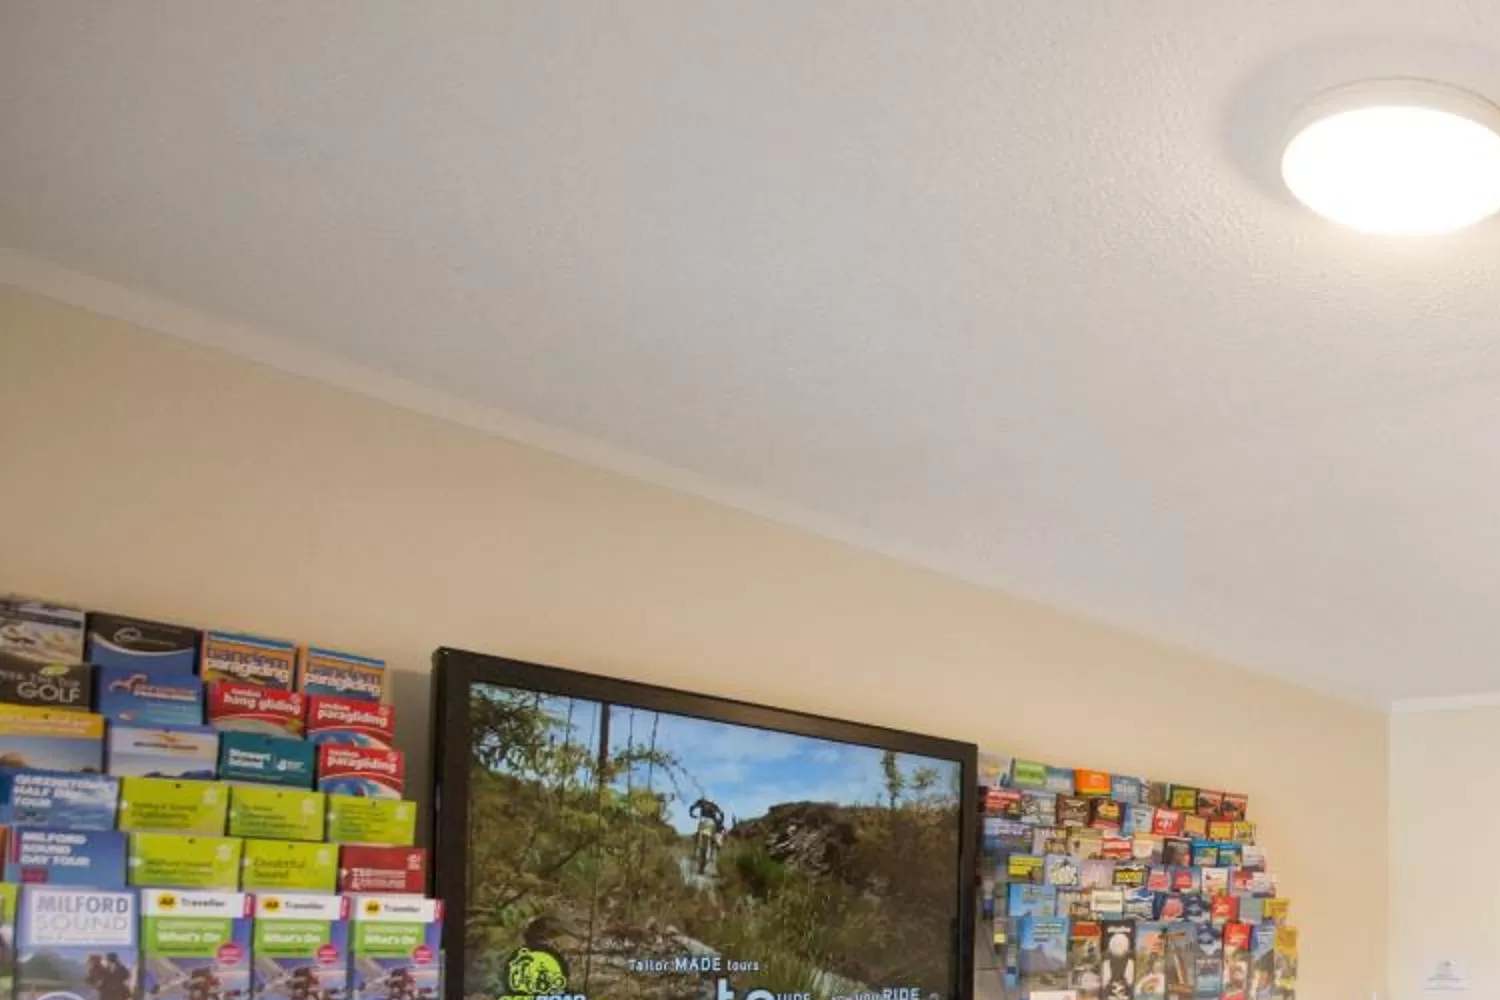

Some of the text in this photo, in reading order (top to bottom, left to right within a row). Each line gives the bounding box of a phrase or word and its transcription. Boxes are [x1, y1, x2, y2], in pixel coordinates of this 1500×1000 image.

[17, 682, 81, 704] GOLF
[22, 832, 88, 845] MILFORD
[22, 843, 72, 855] SOUND
[36, 895, 129, 913] MILFORD
[36, 914, 128, 931] SOUND
[629, 957, 760, 971] Tailor MADE tours
